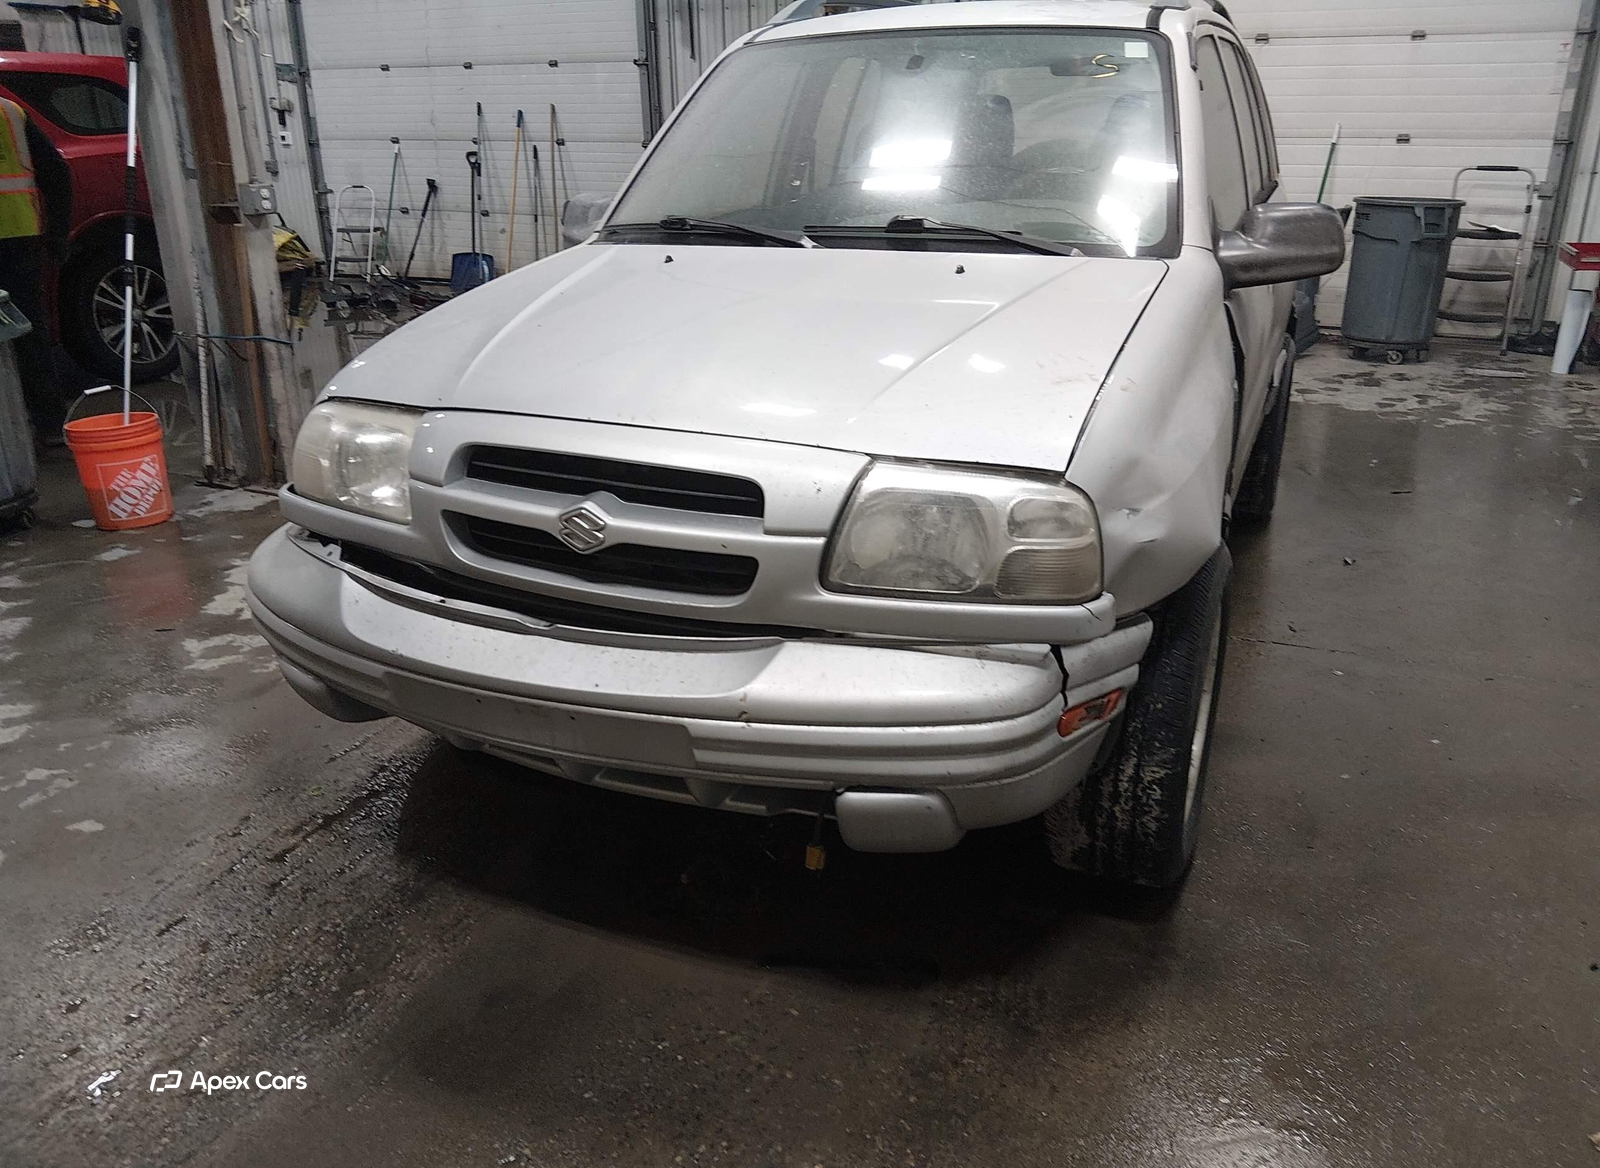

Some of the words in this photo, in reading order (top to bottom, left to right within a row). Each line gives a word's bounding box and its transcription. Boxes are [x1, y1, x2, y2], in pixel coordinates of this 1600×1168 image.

[108, 468, 135, 492] THE
[109, 457, 160, 519] HOME
[133, 477, 163, 517] DEPOT
